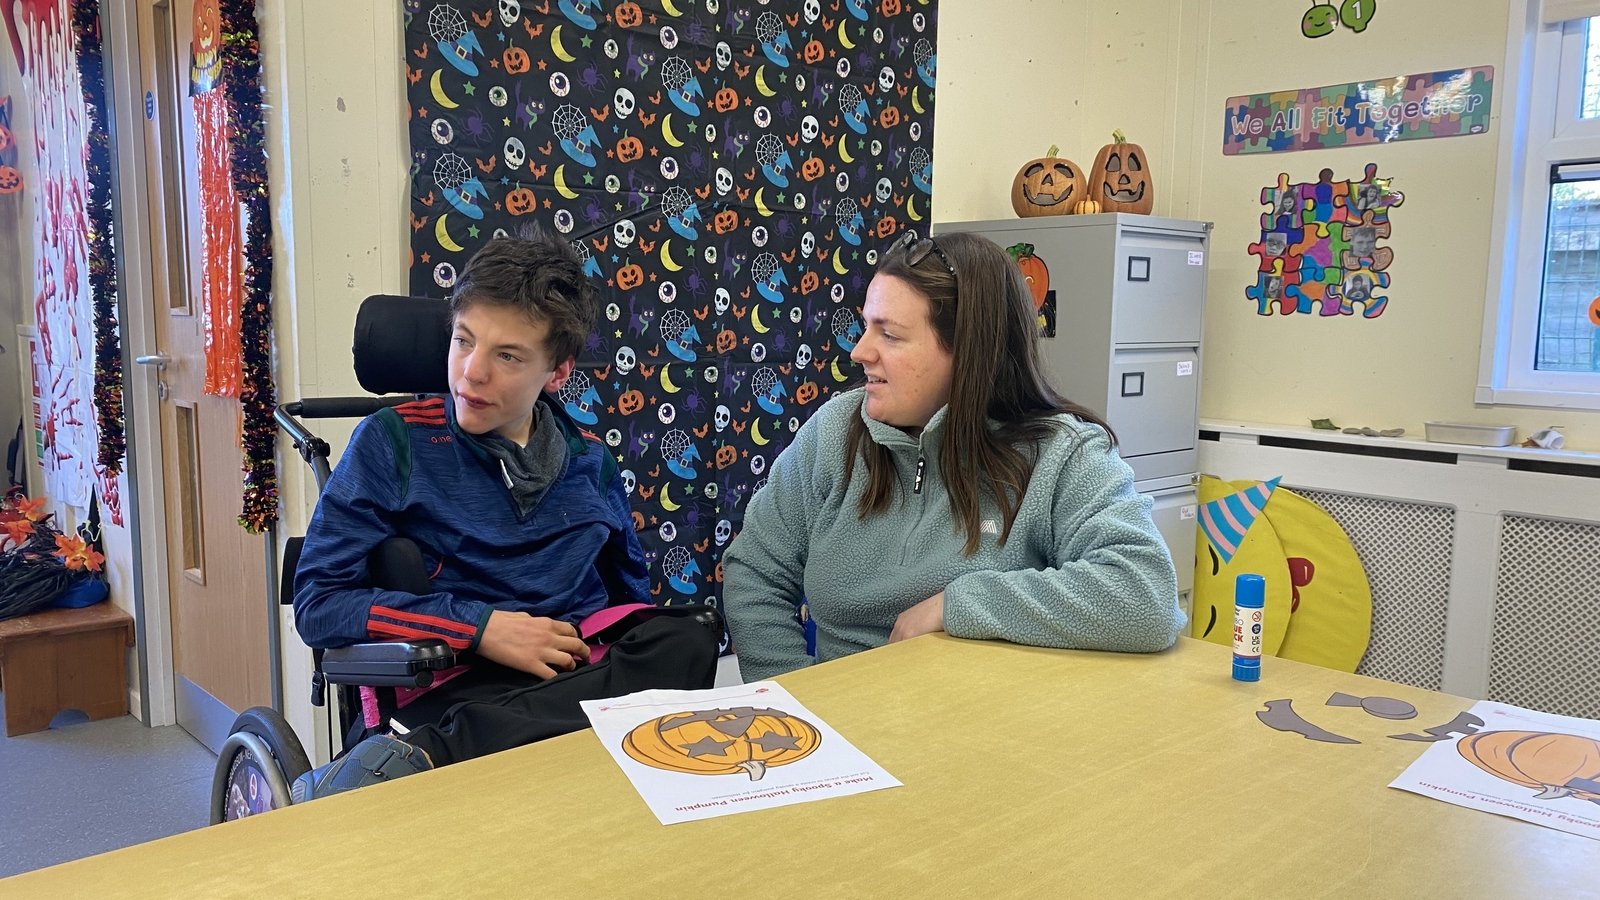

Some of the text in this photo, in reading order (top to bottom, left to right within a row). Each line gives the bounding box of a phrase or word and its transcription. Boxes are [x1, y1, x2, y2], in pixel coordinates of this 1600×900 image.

[1352, 0, 1361, 20] 1
[1231, 114, 1264, 136] We
[1272, 106, 1301, 132] All
[1311, 106, 1346, 128] Fit
[844, 776, 874, 784] Make
[791, 783, 832, 793] Spooky
[1418, 781, 1476, 800] Pumpkin
[730, 789, 791, 803] Halloween
[674, 800, 728, 812] Pumpkin
[1479, 797, 1553, 818] Halloween
[1557, 814, 1600, 829] pooky
